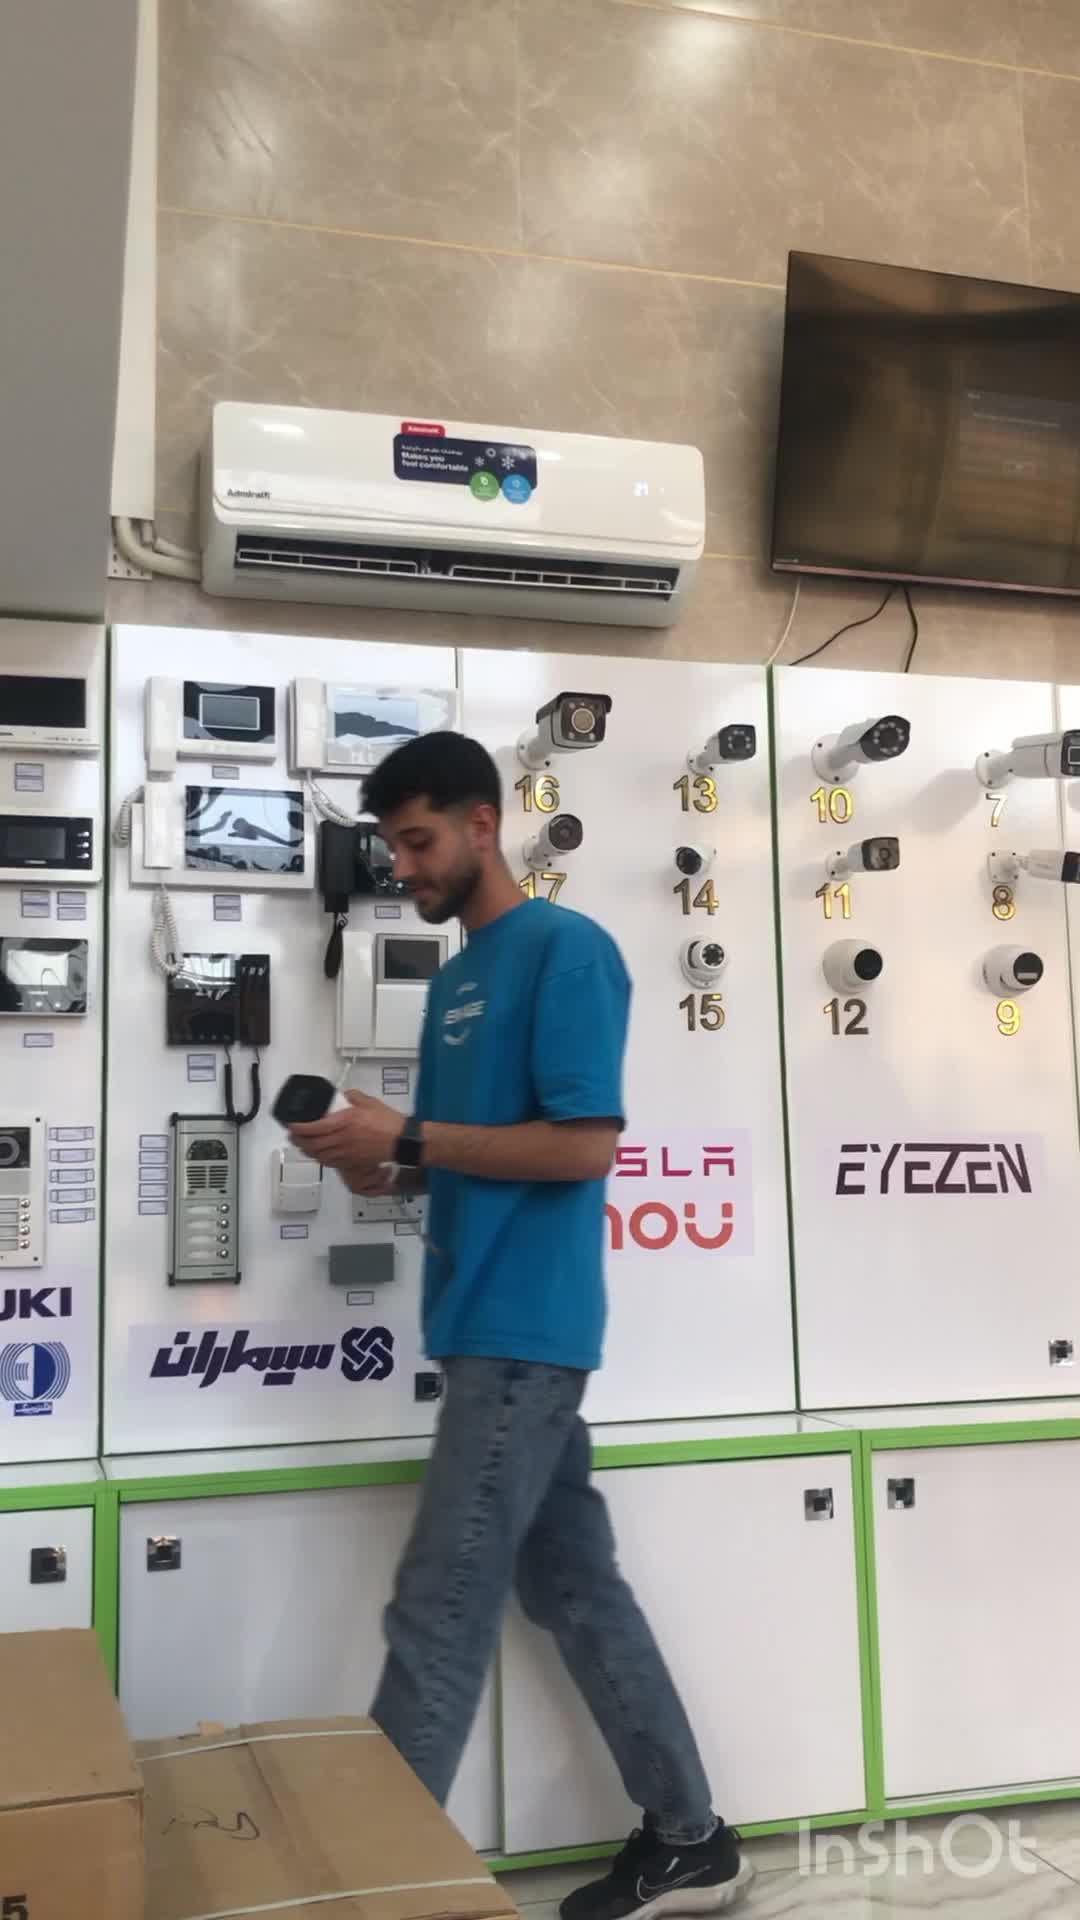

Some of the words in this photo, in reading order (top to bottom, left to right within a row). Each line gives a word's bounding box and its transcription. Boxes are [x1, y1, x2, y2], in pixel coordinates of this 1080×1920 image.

[429, 455, 445, 464] you
[515, 774, 560, 813] 16
[673, 775, 719, 813] 13
[810, 787, 853, 824] 10
[985, 792, 1008, 828] 7
[519, 871, 567, 900] 17
[673, 879, 719, 916] 14
[815, 883, 852, 919] 11
[992, 885, 1016, 920] 8
[679, 994, 726, 1031] 15
[823, 999, 869, 1036] 12
[996, 1000, 1021, 1036] 9
[835, 1143, 1032, 1196] EYEZEN
